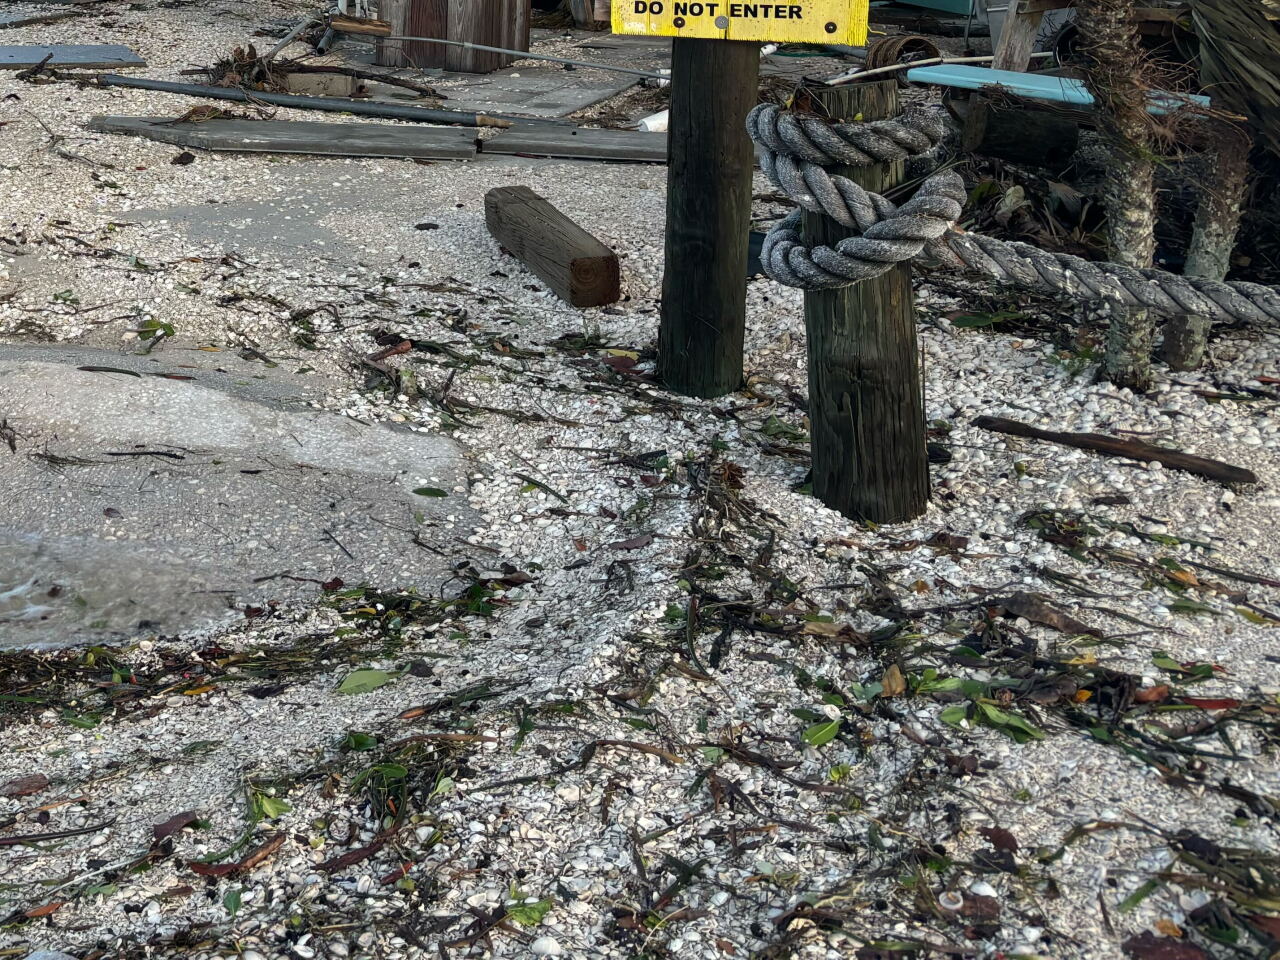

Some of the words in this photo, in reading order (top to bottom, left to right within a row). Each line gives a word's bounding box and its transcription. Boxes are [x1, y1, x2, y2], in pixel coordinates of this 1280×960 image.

[634, 0, 664, 15] DO
[674, 2, 719, 17] NOT
[730, 3, 803, 19] ENTER
